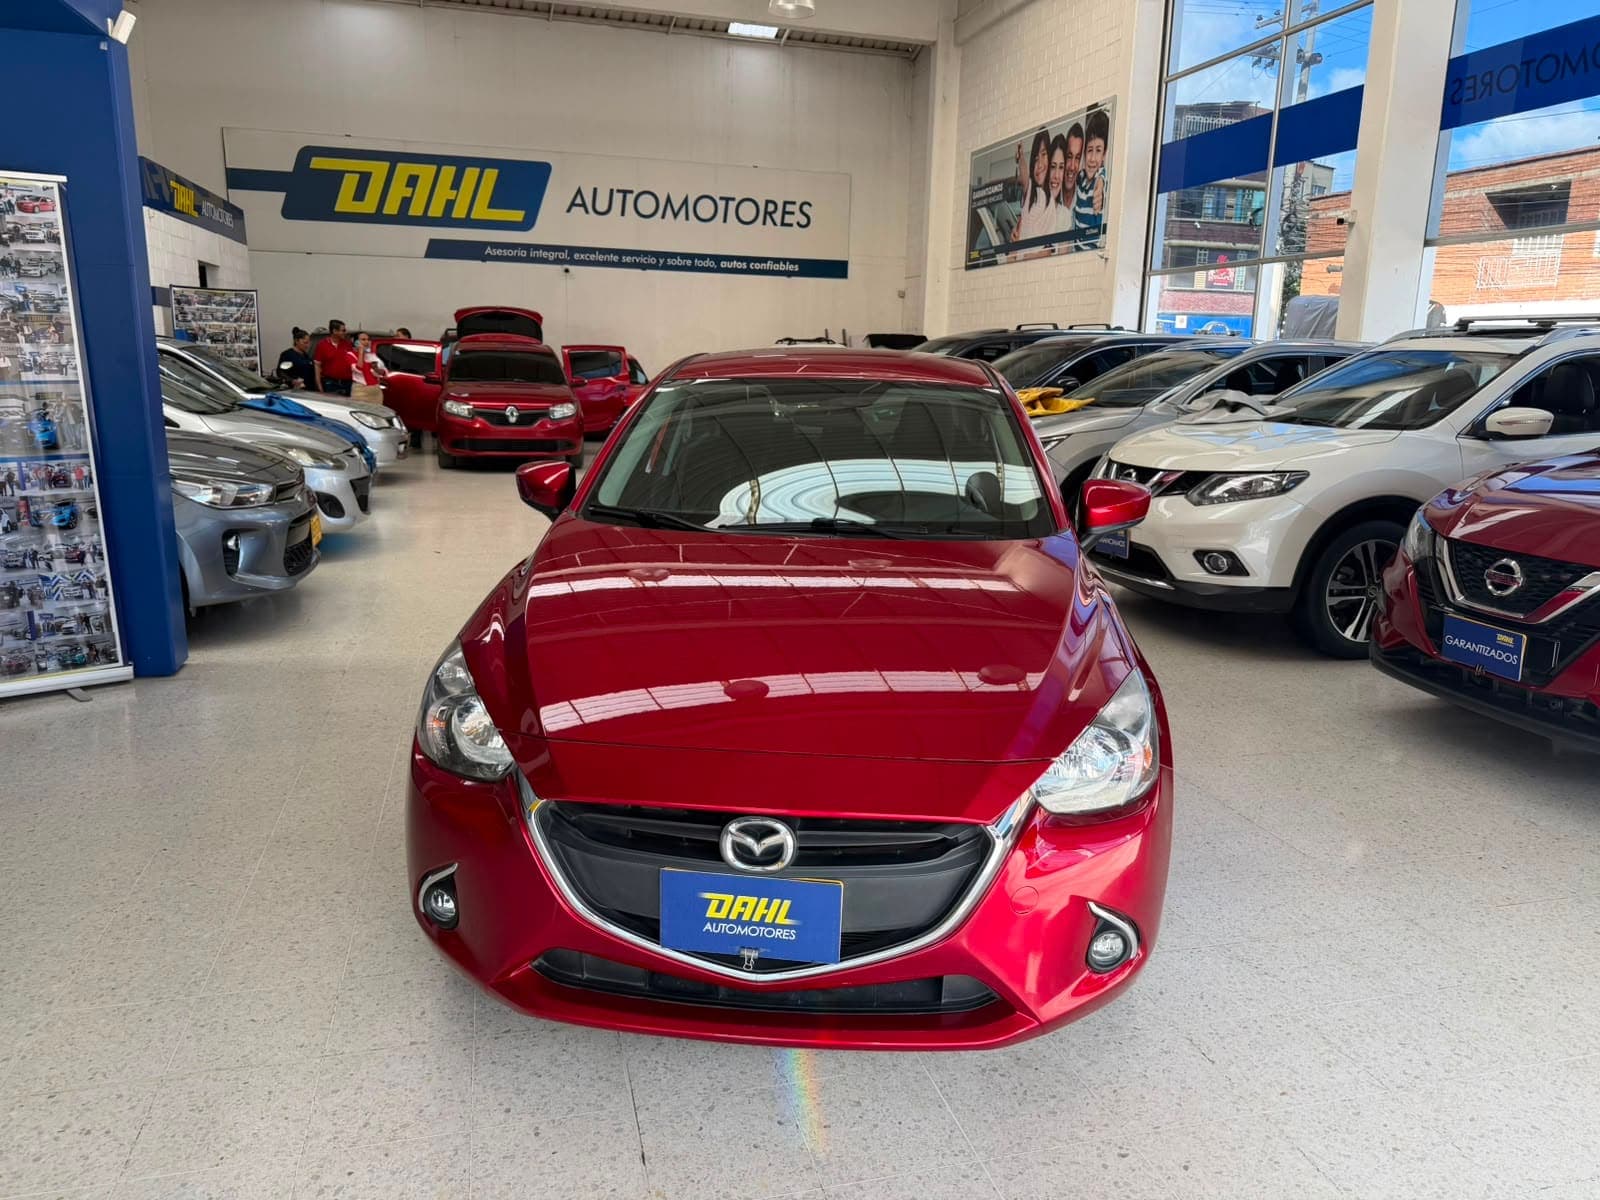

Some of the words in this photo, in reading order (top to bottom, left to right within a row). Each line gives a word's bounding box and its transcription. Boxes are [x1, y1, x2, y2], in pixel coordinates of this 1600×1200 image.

[170, 180, 199, 218] DAHL
[310, 157, 525, 221] DAHL
[566, 186, 813, 229] AUTOMOTORES
[530, 248, 570, 260] integral,
[574, 251, 619, 262] excelente
[622, 255, 656, 265] servicio
[659, 258, 665, 266] y
[667, 256, 692, 266] sobre
[695, 258, 717, 269] todo,
[720, 259, 747, 269] autos
[750, 260, 799, 272] confiables
[1445, 635, 1518, 665] GARANTIZADOS
[698, 892, 802, 925] DAHL
[702, 922, 796, 940] AUTOMOTORES
